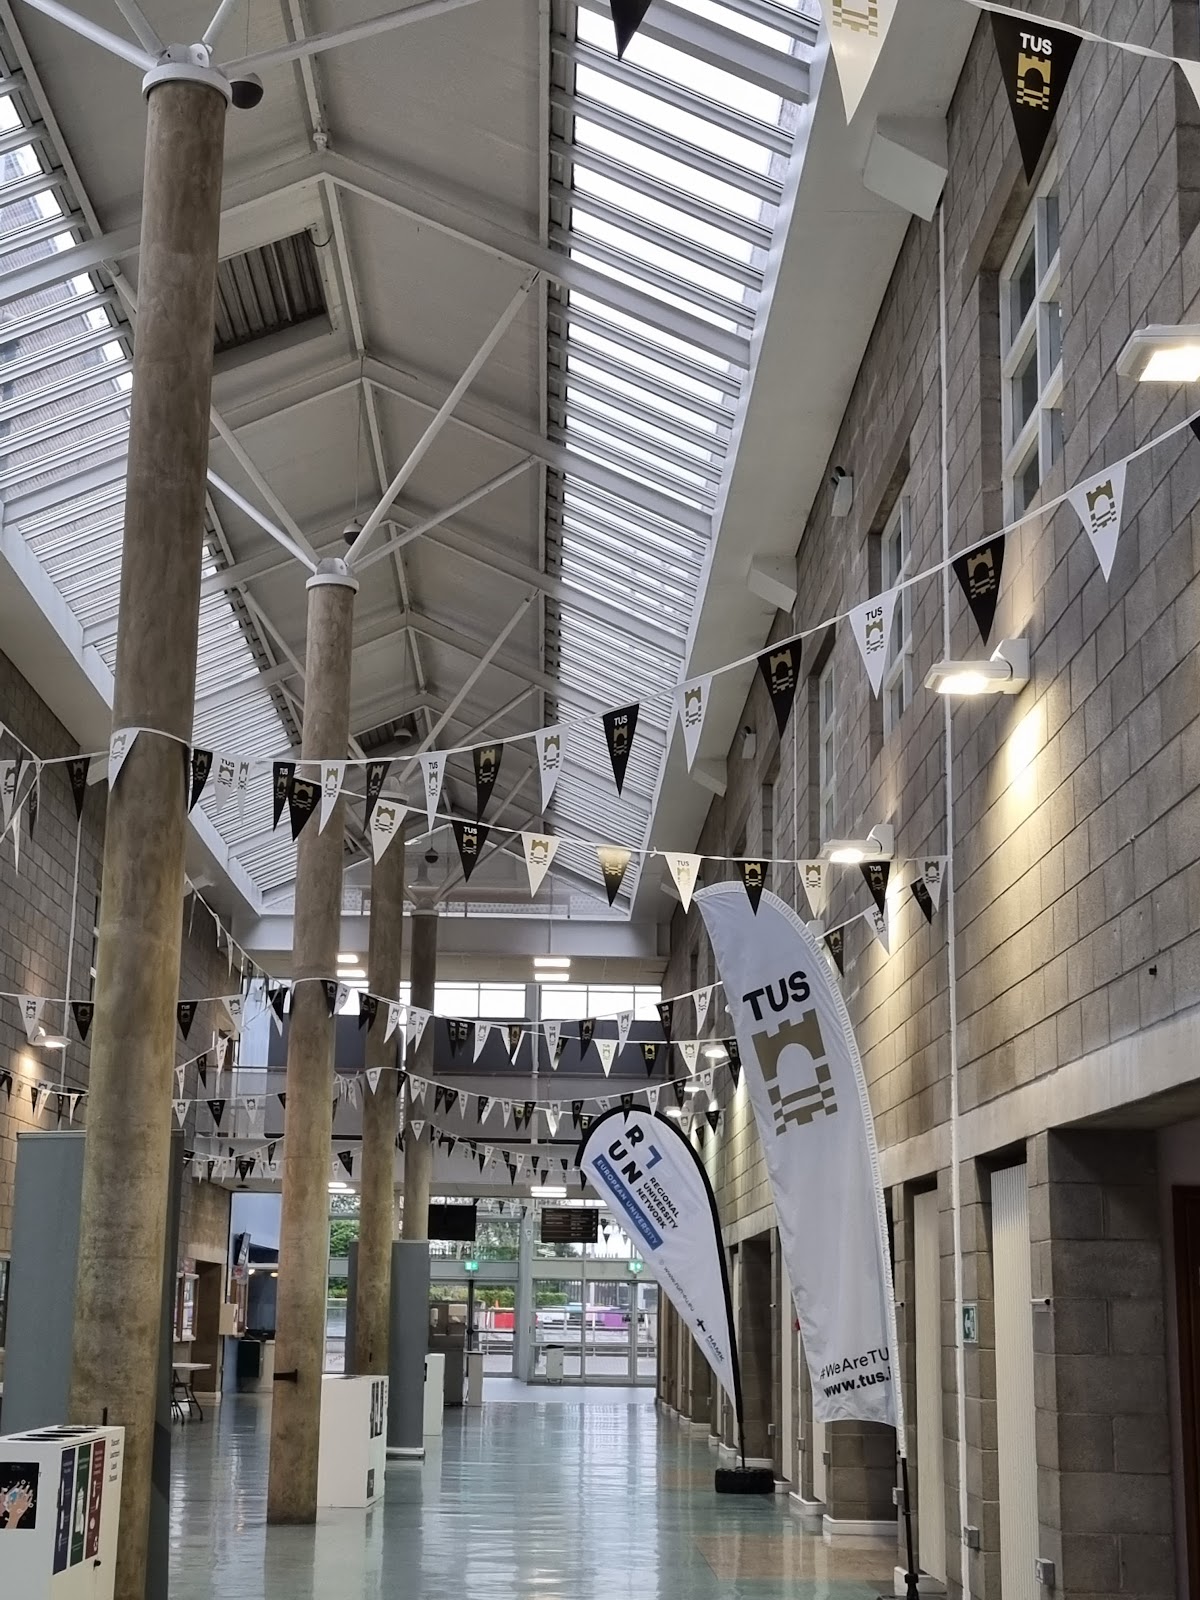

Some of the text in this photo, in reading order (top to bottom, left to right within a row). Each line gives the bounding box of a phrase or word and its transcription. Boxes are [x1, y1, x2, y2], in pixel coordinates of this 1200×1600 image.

[1019, 32, 1052, 56] TUS
[865, 606, 883, 621] TUS
[614, 715, 628, 726] TUS
[220, 758, 235, 768] TUS
[279, 767, 288, 775] TUS
[428, 761, 438, 769] TUS
[464, 826, 477, 835] TUS
[677, 859, 689, 867] TUS
[743, 970, 810, 1021] TUS
[625, 1124, 644, 1148] R
[608, 1139, 643, 1185] UN
[597, 1159, 658, 1245] EUROPEAN UNIVERSITY
[636, 1188, 667, 1230] NETWORK
[643, 1182, 678, 1230] UNIVERSITY
[649, 1177, 680, 1218] REGIONAL
[707, 1335, 725, 1362] HAMK
